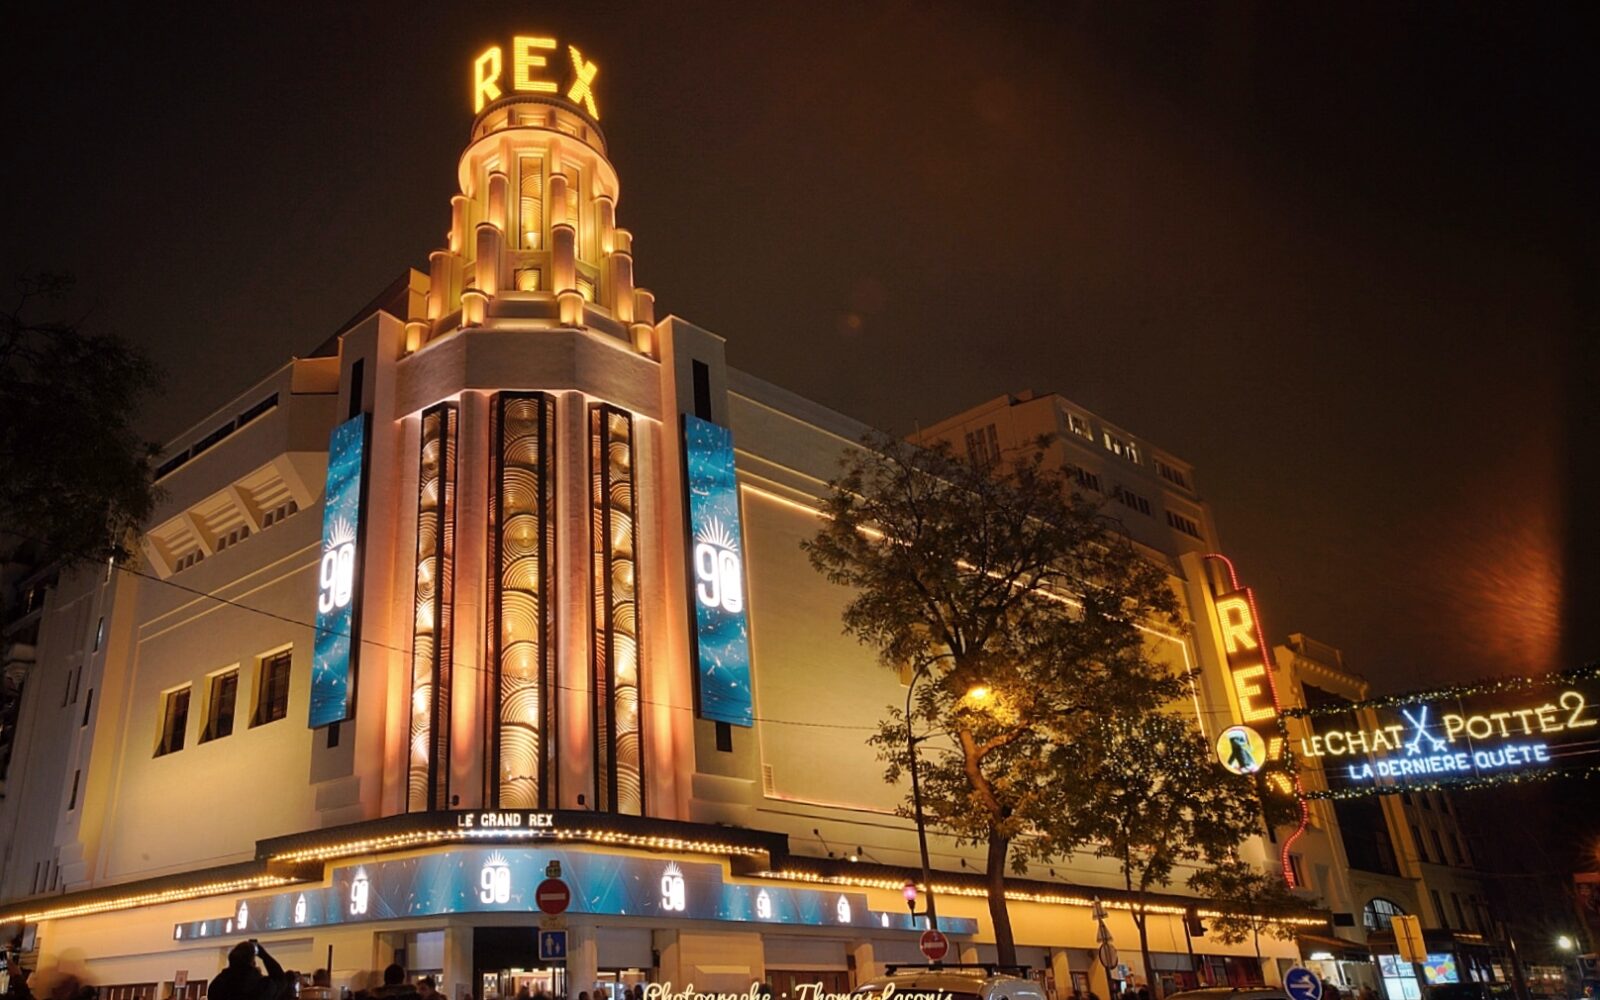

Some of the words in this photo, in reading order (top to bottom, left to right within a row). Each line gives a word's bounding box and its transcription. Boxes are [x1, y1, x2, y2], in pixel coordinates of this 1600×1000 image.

[475, 36, 599, 120] REX
[319, 543, 354, 614] 90
[695, 543, 742, 614] 90
[1349, 763, 1374, 780] LA
[1378, 752, 1471, 778] DERNIERE
[458, 814, 474, 827] LE
[481, 813, 521, 827] GRAND
[528, 814, 553, 827] REX
[480, 867, 511, 904] 90
[661, 876, 686, 911] 90
